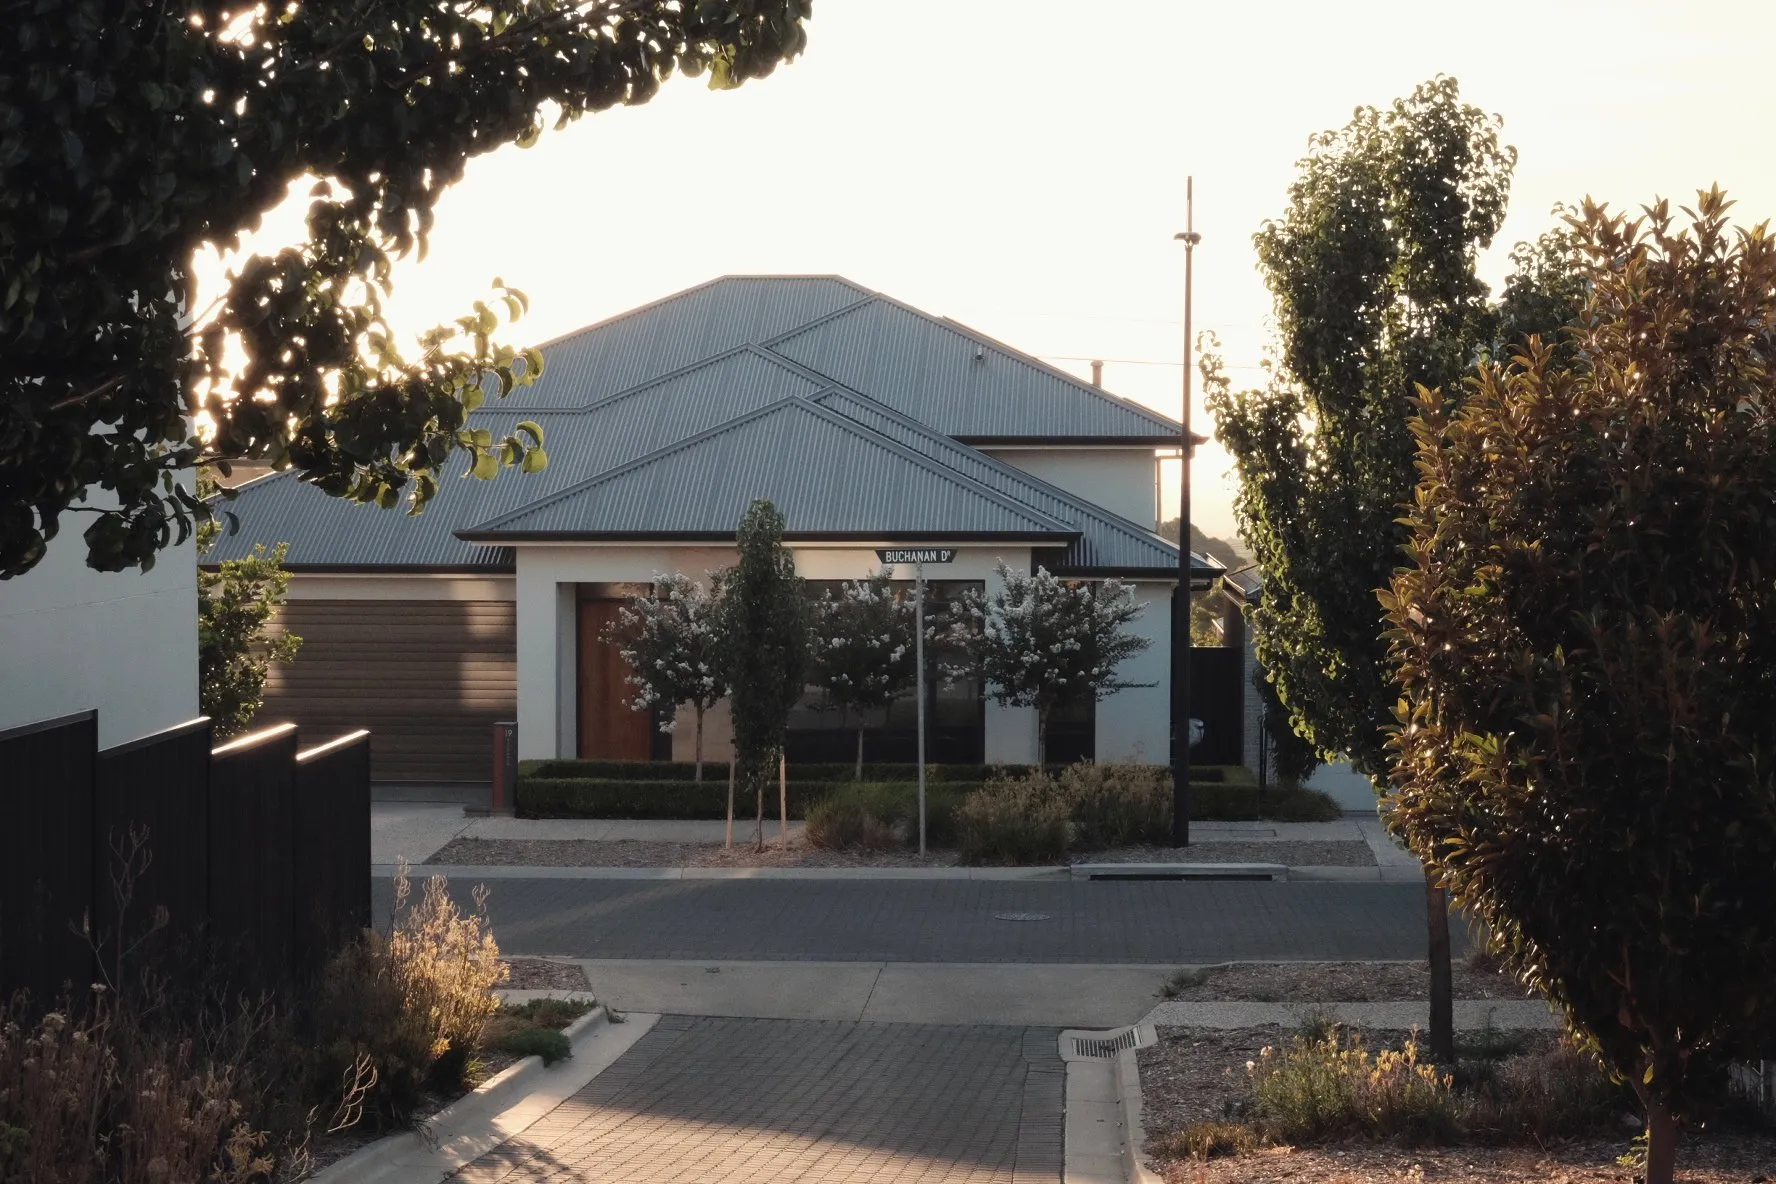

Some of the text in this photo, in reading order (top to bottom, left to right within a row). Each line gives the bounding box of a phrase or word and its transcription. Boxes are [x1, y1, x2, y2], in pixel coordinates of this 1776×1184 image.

[885, 550, 951, 562] BUCHANAN DR
[504, 729, 513, 737] 19
